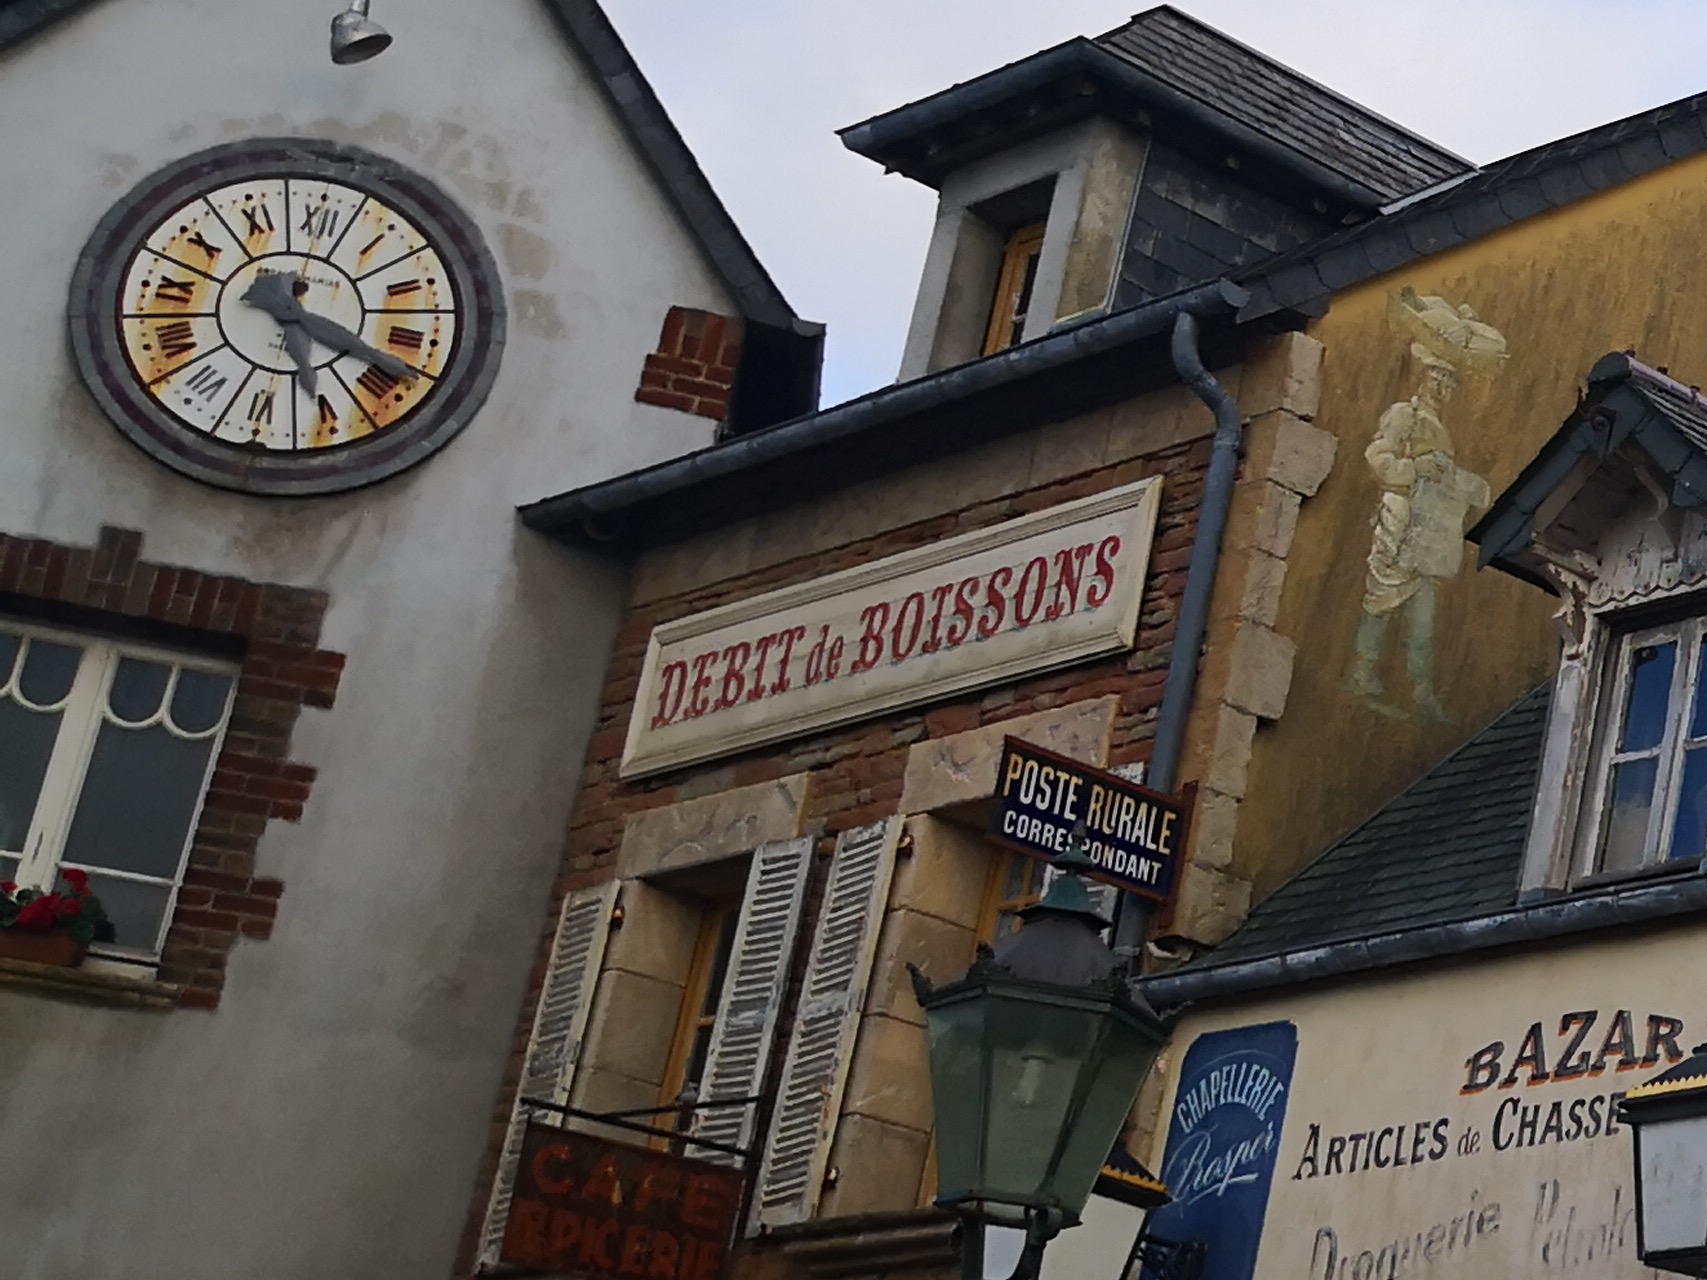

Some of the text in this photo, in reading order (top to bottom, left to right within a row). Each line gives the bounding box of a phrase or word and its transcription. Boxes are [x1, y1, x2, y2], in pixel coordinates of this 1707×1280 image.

[187, 231, 223, 258] X
[300, 203, 339, 239] XII
[651, 534, 1122, 731] DEBIT de BOISSONS
[1002, 751, 1178, 857] POSTE RURALE
[1459, 1008, 1685, 1098] BAZAR
[1176, 1061, 1285, 1135] CHAPELLERIE
[1457, 1128, 1481, 1158] de
[1491, 1091, 1630, 1154] CHASSE
[531, 1142, 728, 1231] CAFE
